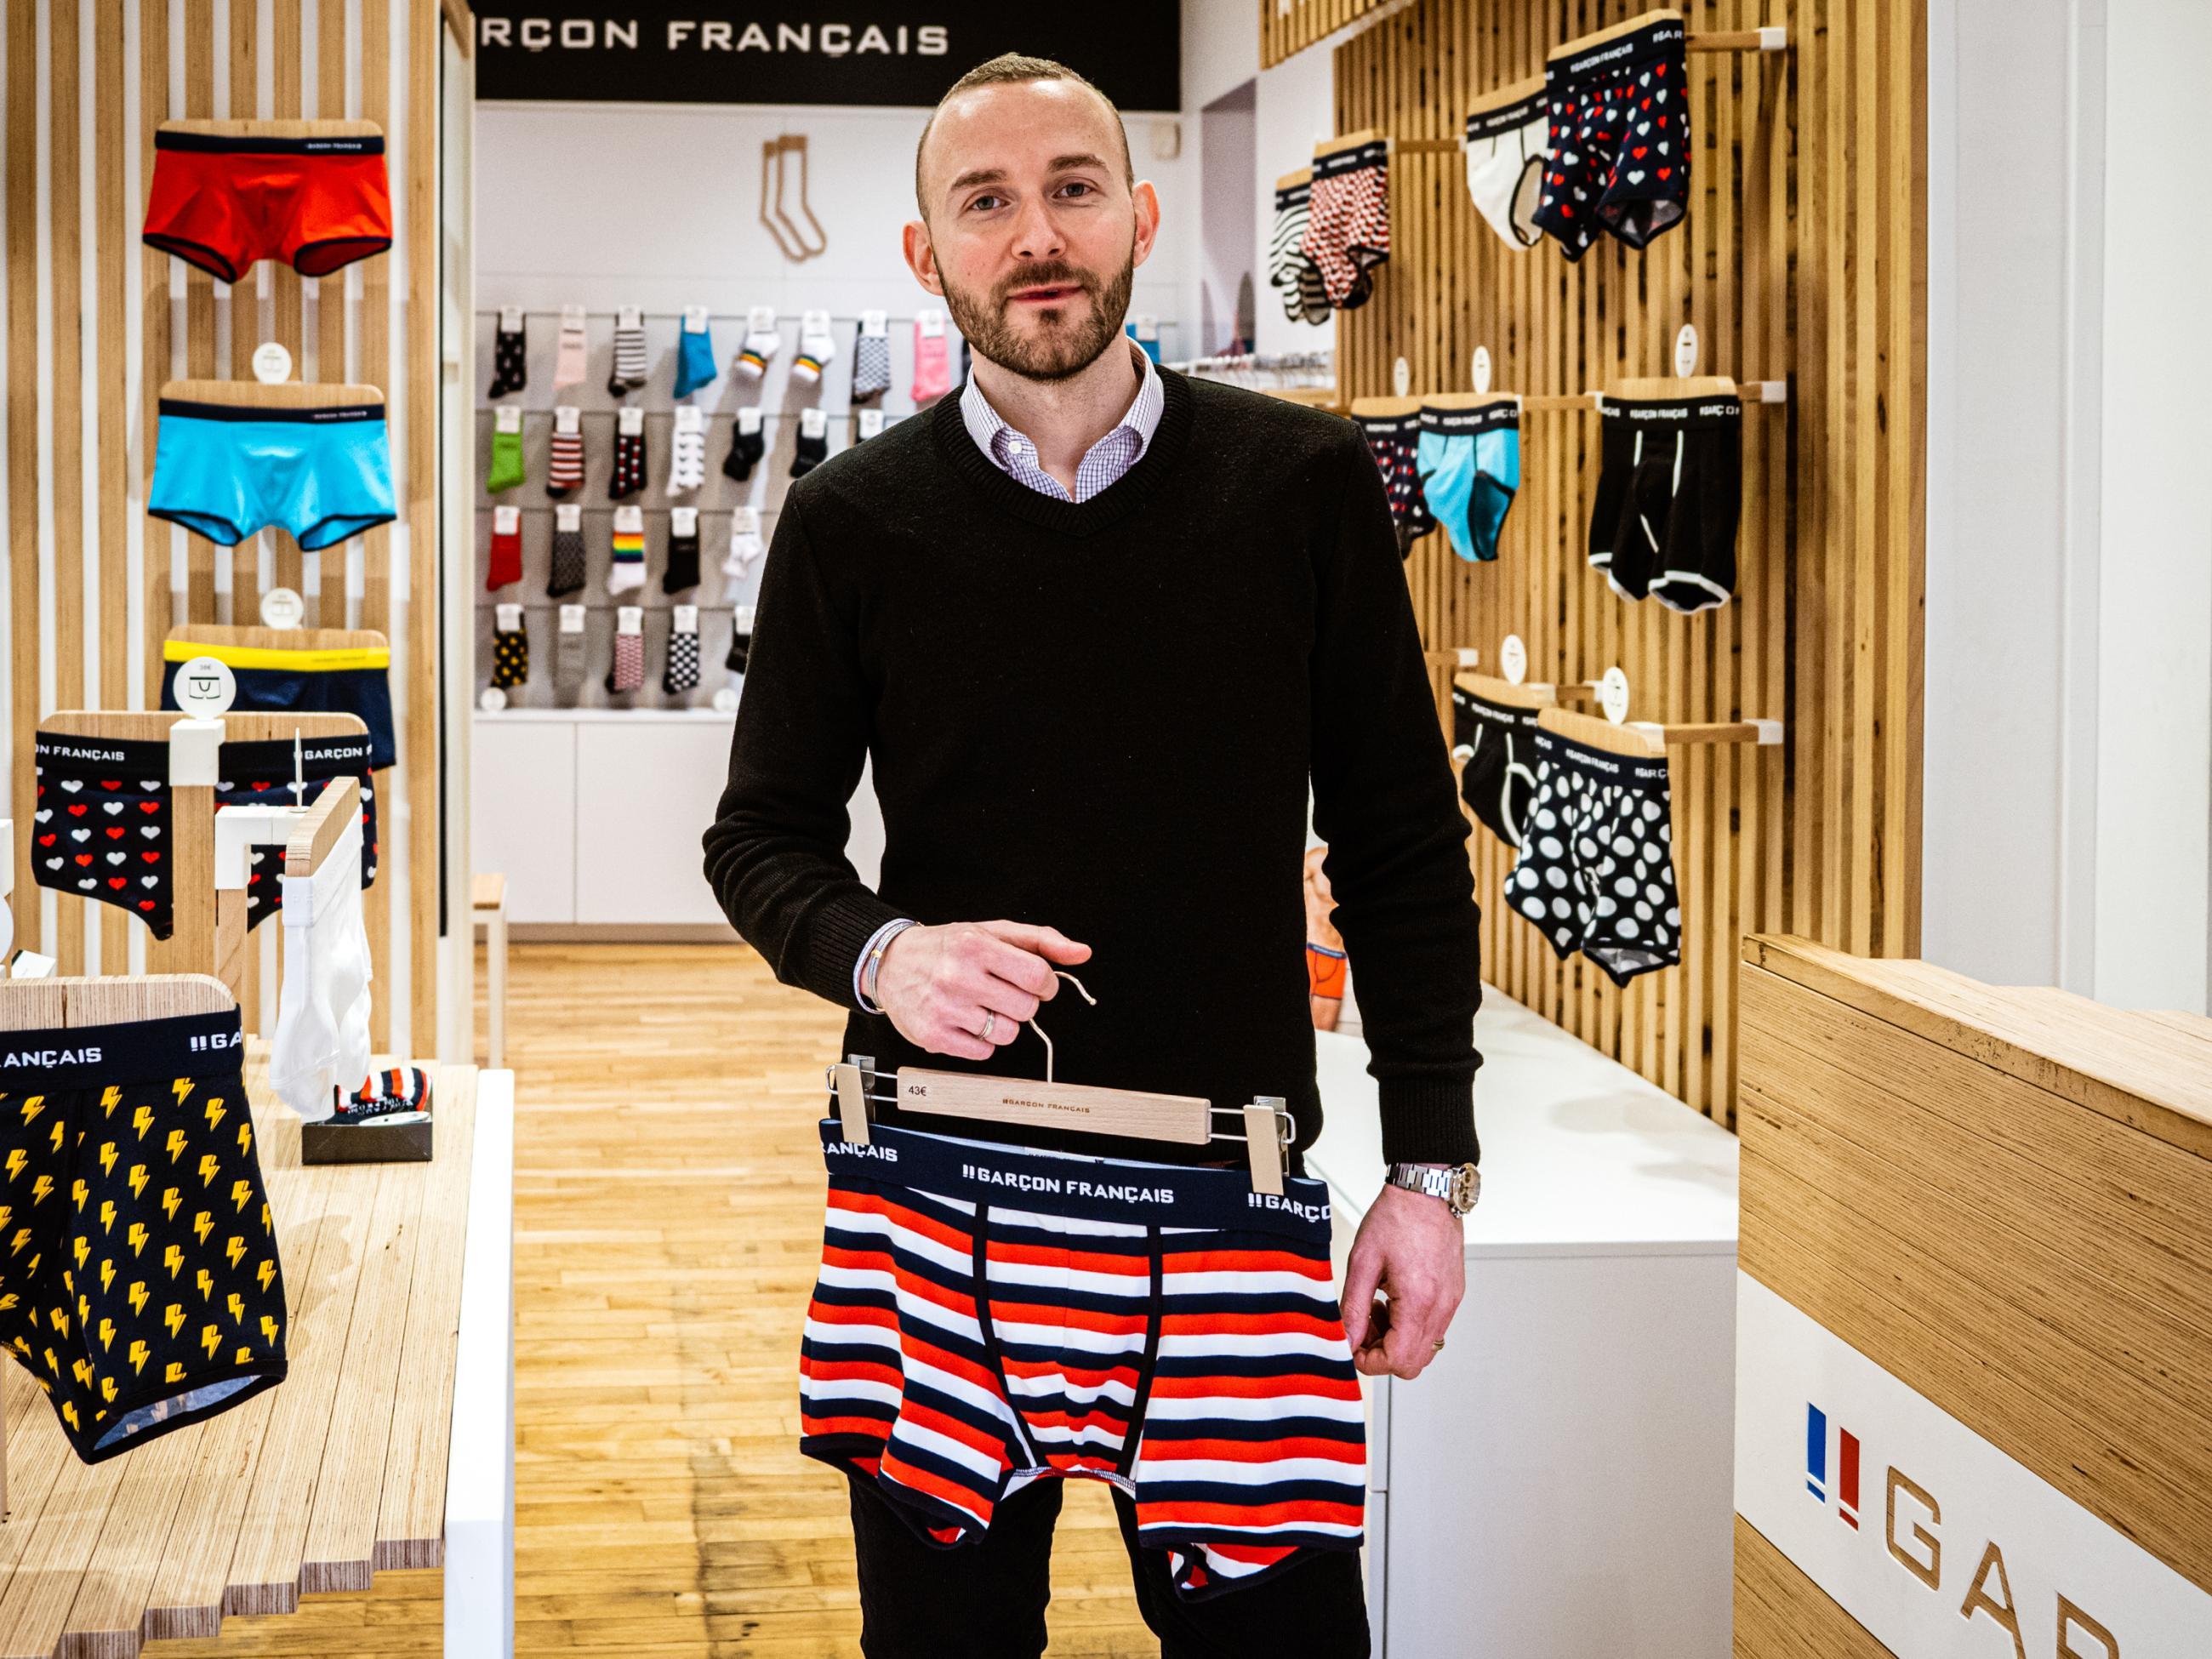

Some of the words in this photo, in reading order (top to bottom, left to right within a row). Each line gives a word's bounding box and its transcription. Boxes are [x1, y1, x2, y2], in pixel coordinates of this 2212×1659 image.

[667, 21, 949, 57] FRANÇAIS
[53, 746, 125, 761] FRANÇAIS
[0, 1047, 102, 1069] ANÇAIS
[908, 1085, 926, 1097] 43€
[1066, 1180, 1174, 1204] FRANÇAIS
